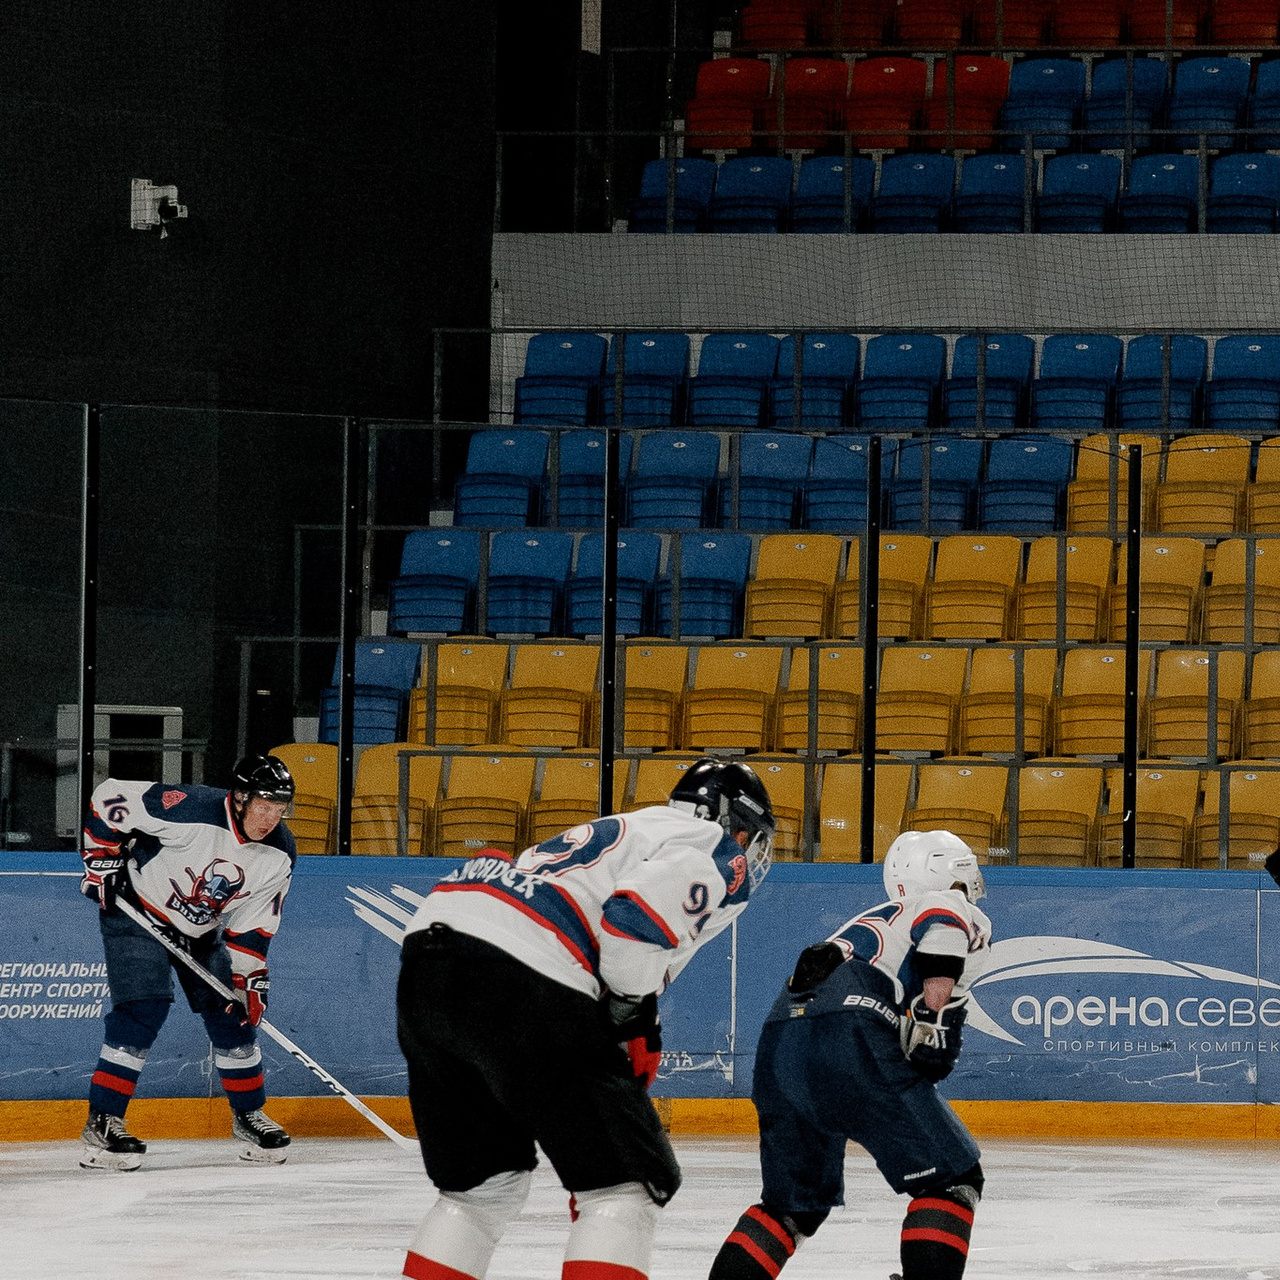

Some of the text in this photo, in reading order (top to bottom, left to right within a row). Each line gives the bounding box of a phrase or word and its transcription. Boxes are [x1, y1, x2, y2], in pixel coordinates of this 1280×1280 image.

[103, 794, 130, 824] 16
[0, 983, 43, 998] ЕНТР
[843, 995, 900, 1029] BAUER
[1043, 1039, 1177, 1053] СПОРТИВНЫЙ
